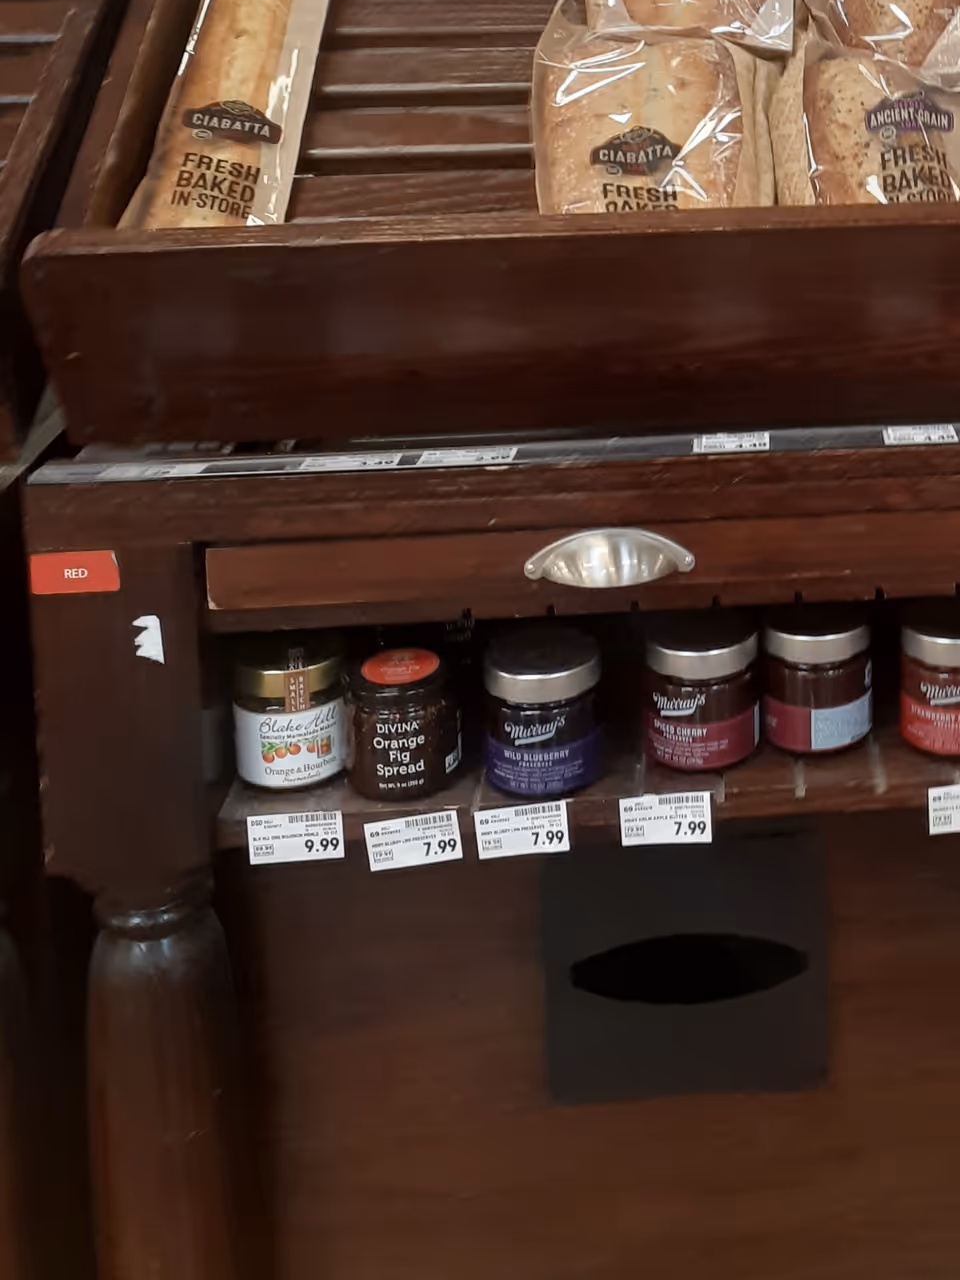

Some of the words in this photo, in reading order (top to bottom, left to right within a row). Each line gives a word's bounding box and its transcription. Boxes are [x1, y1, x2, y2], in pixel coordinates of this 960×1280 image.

[192, 113, 271, 138] CIABATTA
[870, 107, 915, 129] ANCIENT
[599, 145, 673, 164] CIABATTA
[880, 143, 948, 171] FRESH
[181, 152, 261, 185] FRESH
[176, 170, 256, 203] BAKED
[882, 163, 952, 194] BAKED
[602, 183, 678, 203] FRESH
[171, 189, 253, 220] IN-STORE
[64, 568, 88, 579] RED
[653, 691, 707, 716] Murray's
[259, 717, 303, 734] Blake
[304, 705, 337, 730] Hill
[376, 720, 420, 734] DIVINA
[504, 714, 566, 744] Murray's
[373, 734, 426, 750] Orange
[676, 727, 708, 738] CHERRY
[388, 750, 410, 764] Fig
[503, 749, 522, 761] WILD
[523, 747, 569, 762] BLUEBERRY
[264, 766, 295, 777] Orange
[296, 765, 302, 774] &
[376, 759, 426, 778] Spread
[531, 829, 565, 846] 7.99
[674, 820, 707, 836] 7.99
[304, 836, 340, 853] 9.99
[423, 837, 457, 857] 7.99
